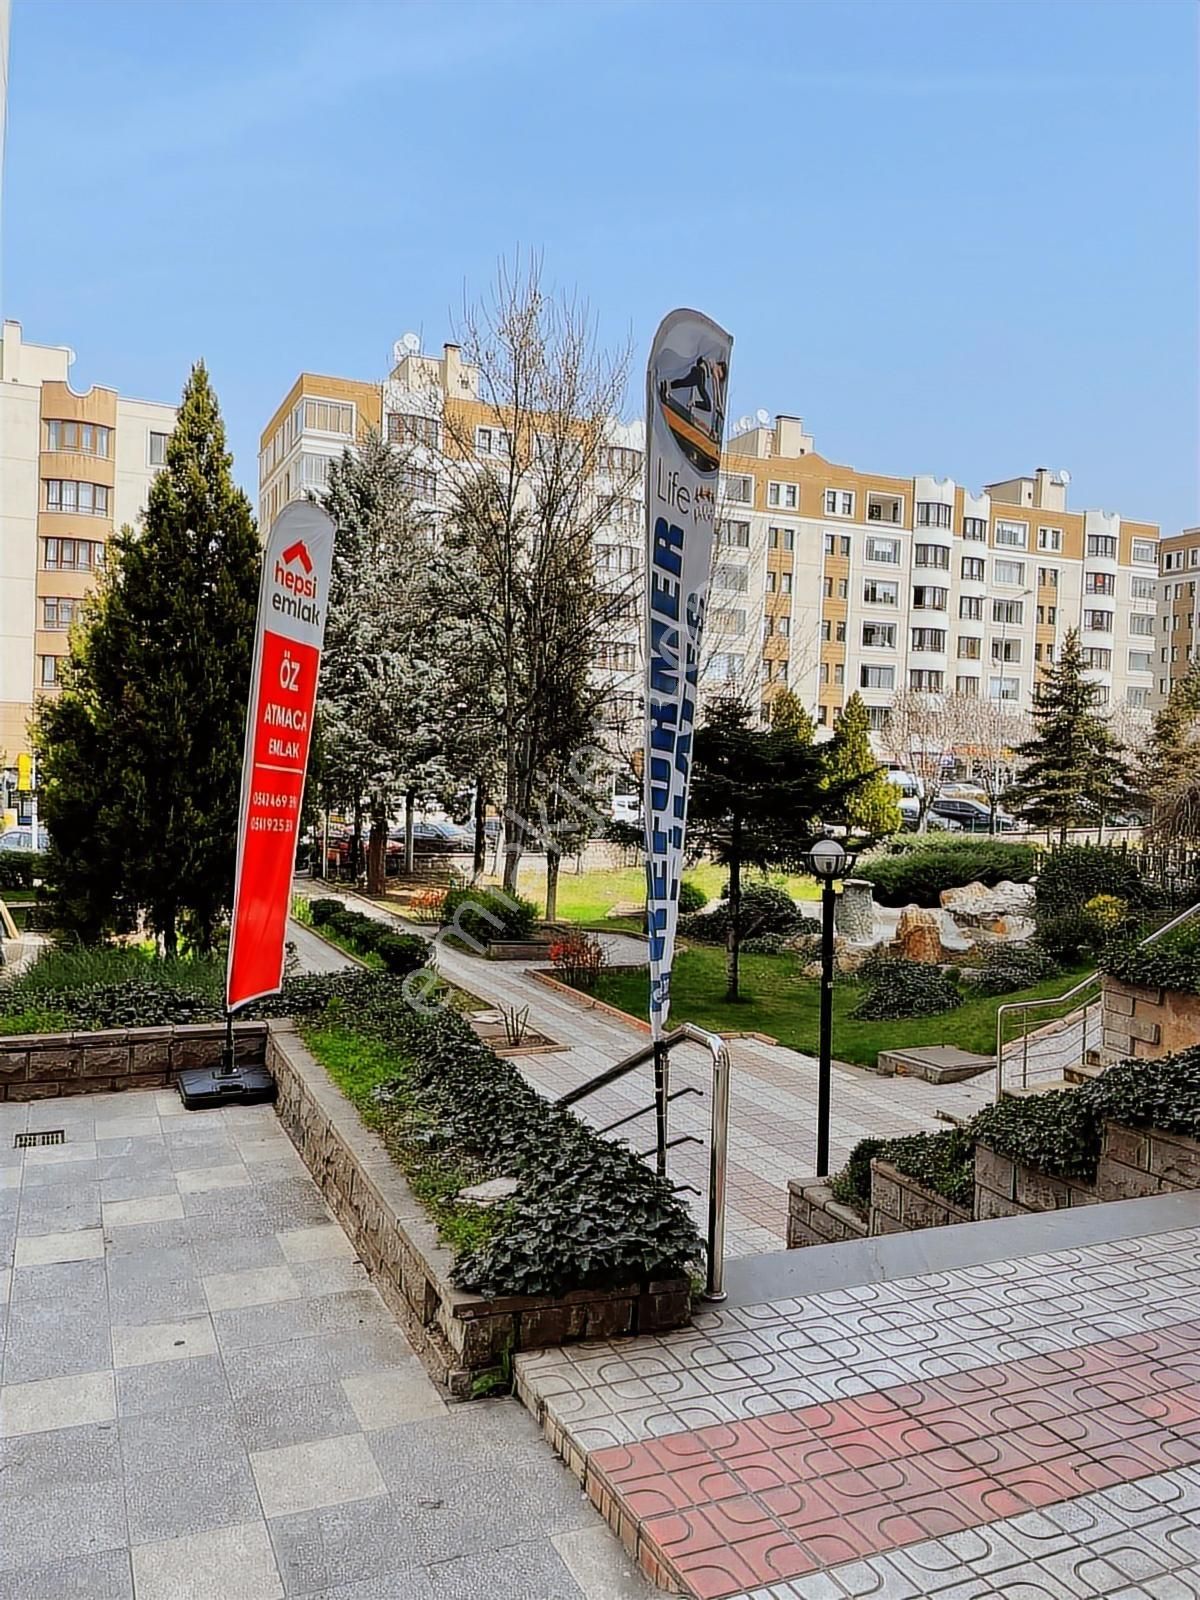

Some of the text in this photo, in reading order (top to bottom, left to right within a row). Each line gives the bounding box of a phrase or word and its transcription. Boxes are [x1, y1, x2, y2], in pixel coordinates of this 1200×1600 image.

[657, 457, 690, 514] Life
[274, 560, 317, 598] hepsi
[272, 592, 320, 626] emlak
[280, 650, 300, 691] ÖZ
[264, 703, 307, 731] ATMACA
[268, 737, 300, 758] EMLAK
[647, 517, 684, 961] REFORMER
